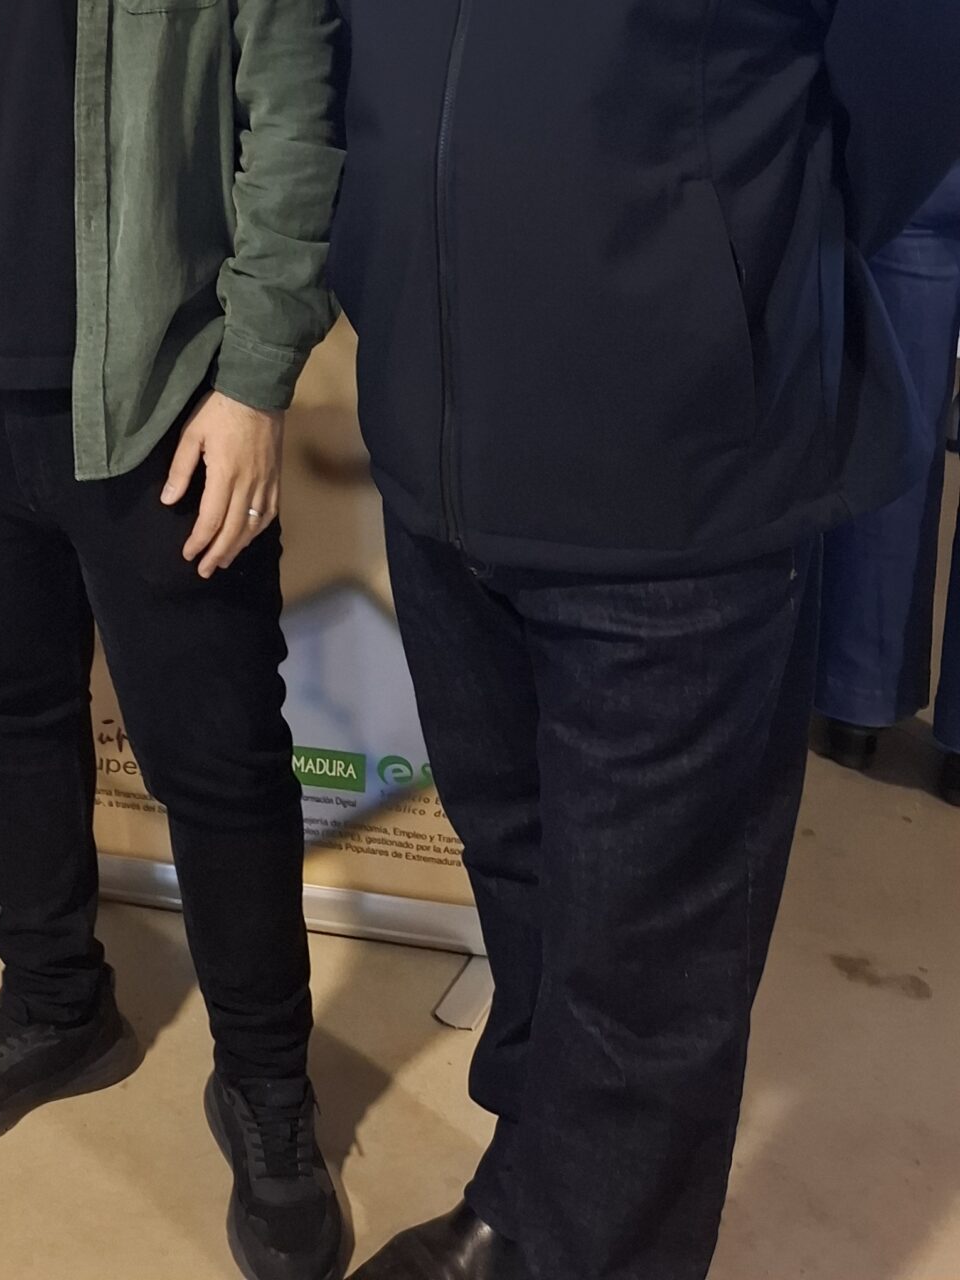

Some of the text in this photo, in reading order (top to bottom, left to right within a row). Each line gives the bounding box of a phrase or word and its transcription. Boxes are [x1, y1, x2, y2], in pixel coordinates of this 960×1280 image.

[365, 835, 414, 850] gestionado
[416, 843, 431, 852] por
[433, 845, 442, 853] la
[393, 827, 427, 841] Empleo
[429, 833, 436, 843] y
[345, 842, 390, 857] Populares
[392, 849, 403, 859] de
[405, 852, 461, 868] Extremadura
